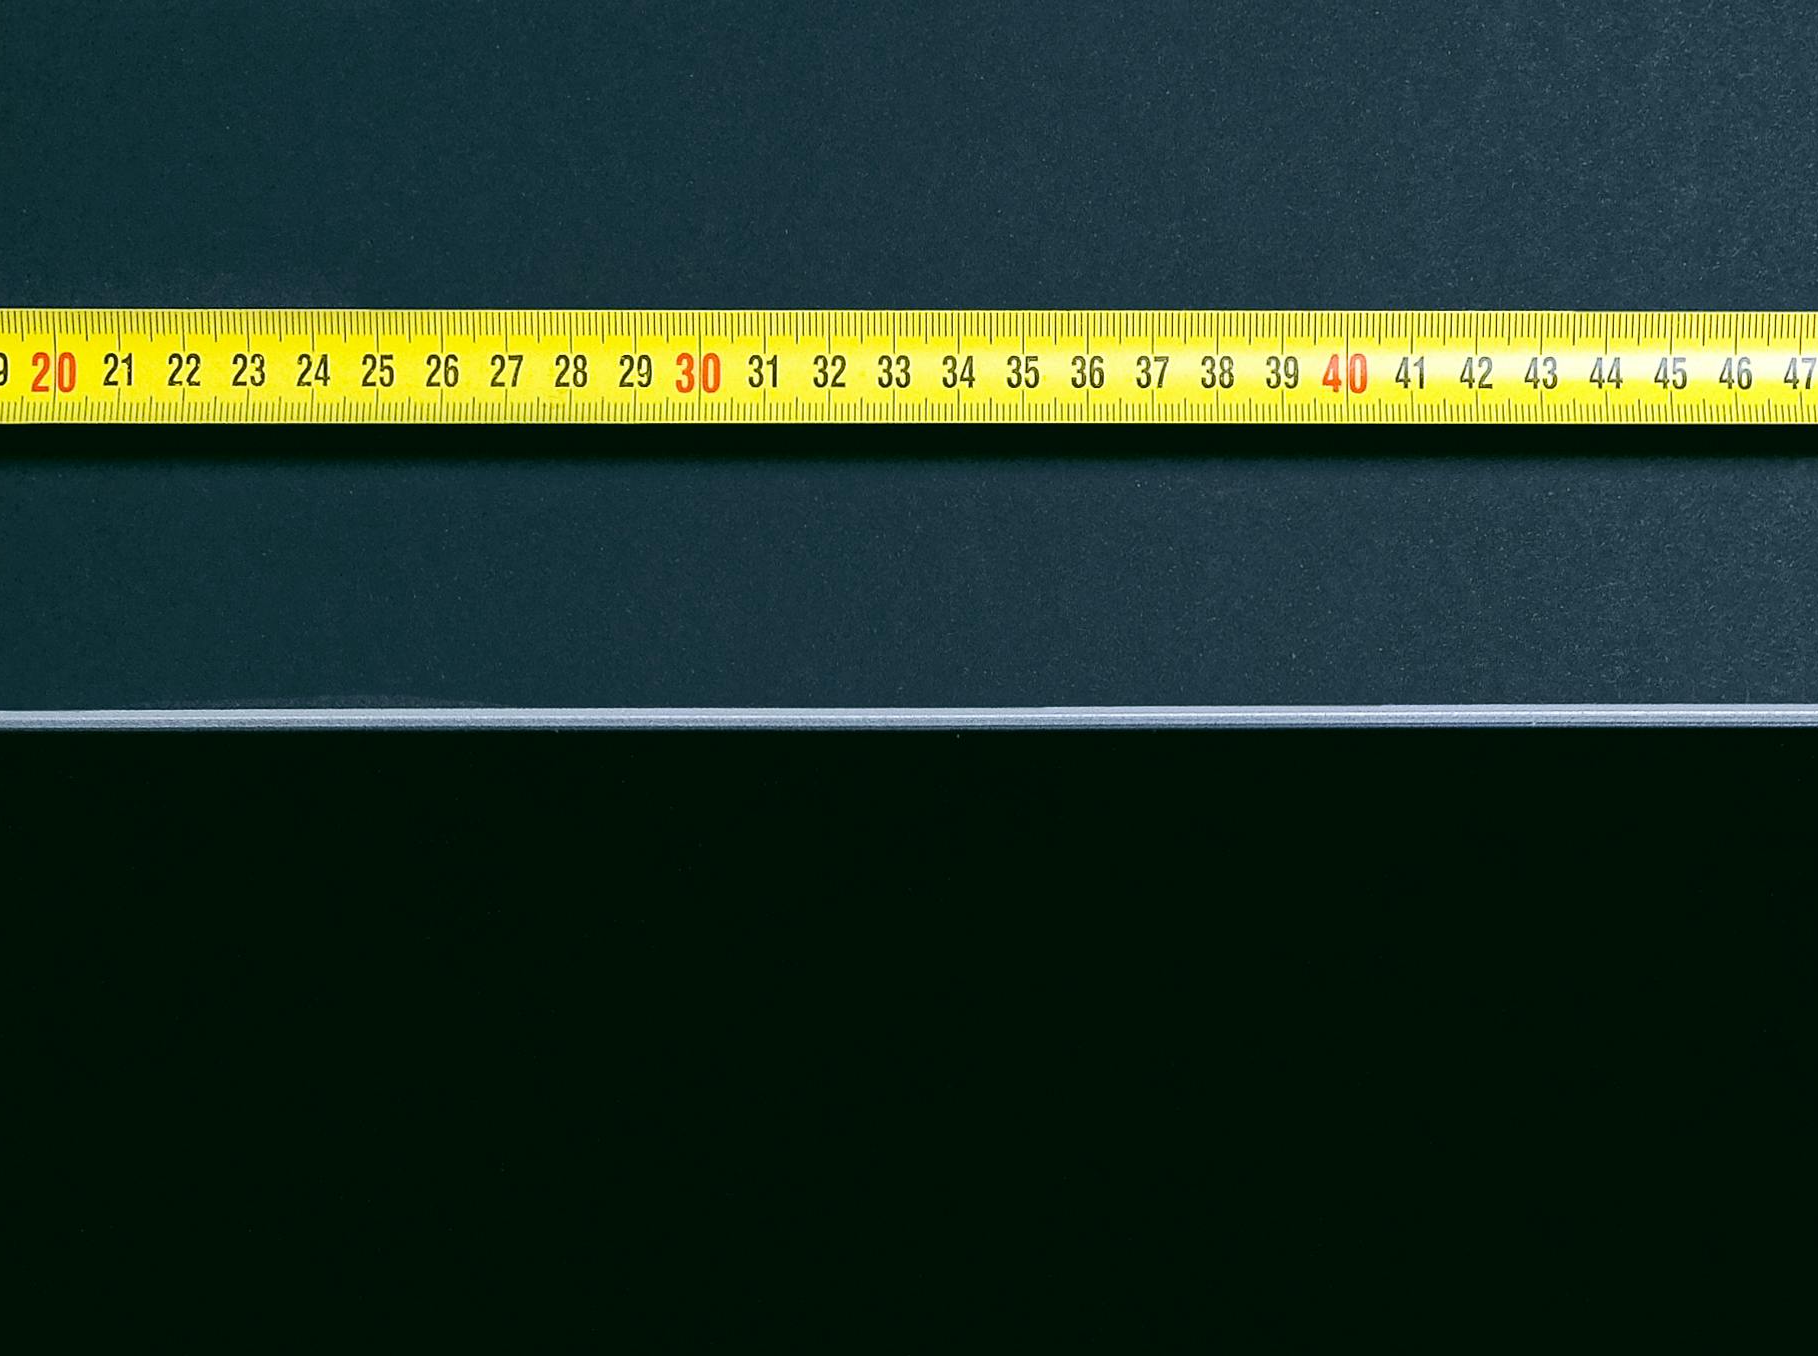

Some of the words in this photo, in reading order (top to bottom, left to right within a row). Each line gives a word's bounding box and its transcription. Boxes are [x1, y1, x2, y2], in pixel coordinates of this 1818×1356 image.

[31, 352, 77, 392] 20
[103, 352, 132, 386] 21
[167, 353, 201, 386] 22
[361, 354, 394, 387] 25
[555, 354, 587, 387] 28
[619, 355, 652, 387] 29
[675, 352, 721, 393] 30
[748, 354, 777, 388] 31
[813, 355, 846, 388] 32
[1007, 355, 1039, 388] 35
[1136, 356, 1169, 389] 37
[1266, 356, 1299, 389] 39
[1322, 354, 1367, 393] 40
[1395, 356, 1424, 389] 41
[1460, 357, 1493, 389] 42
[1654, 357, 1687, 390] 45
[1784, 358, 1816, 389] 47
